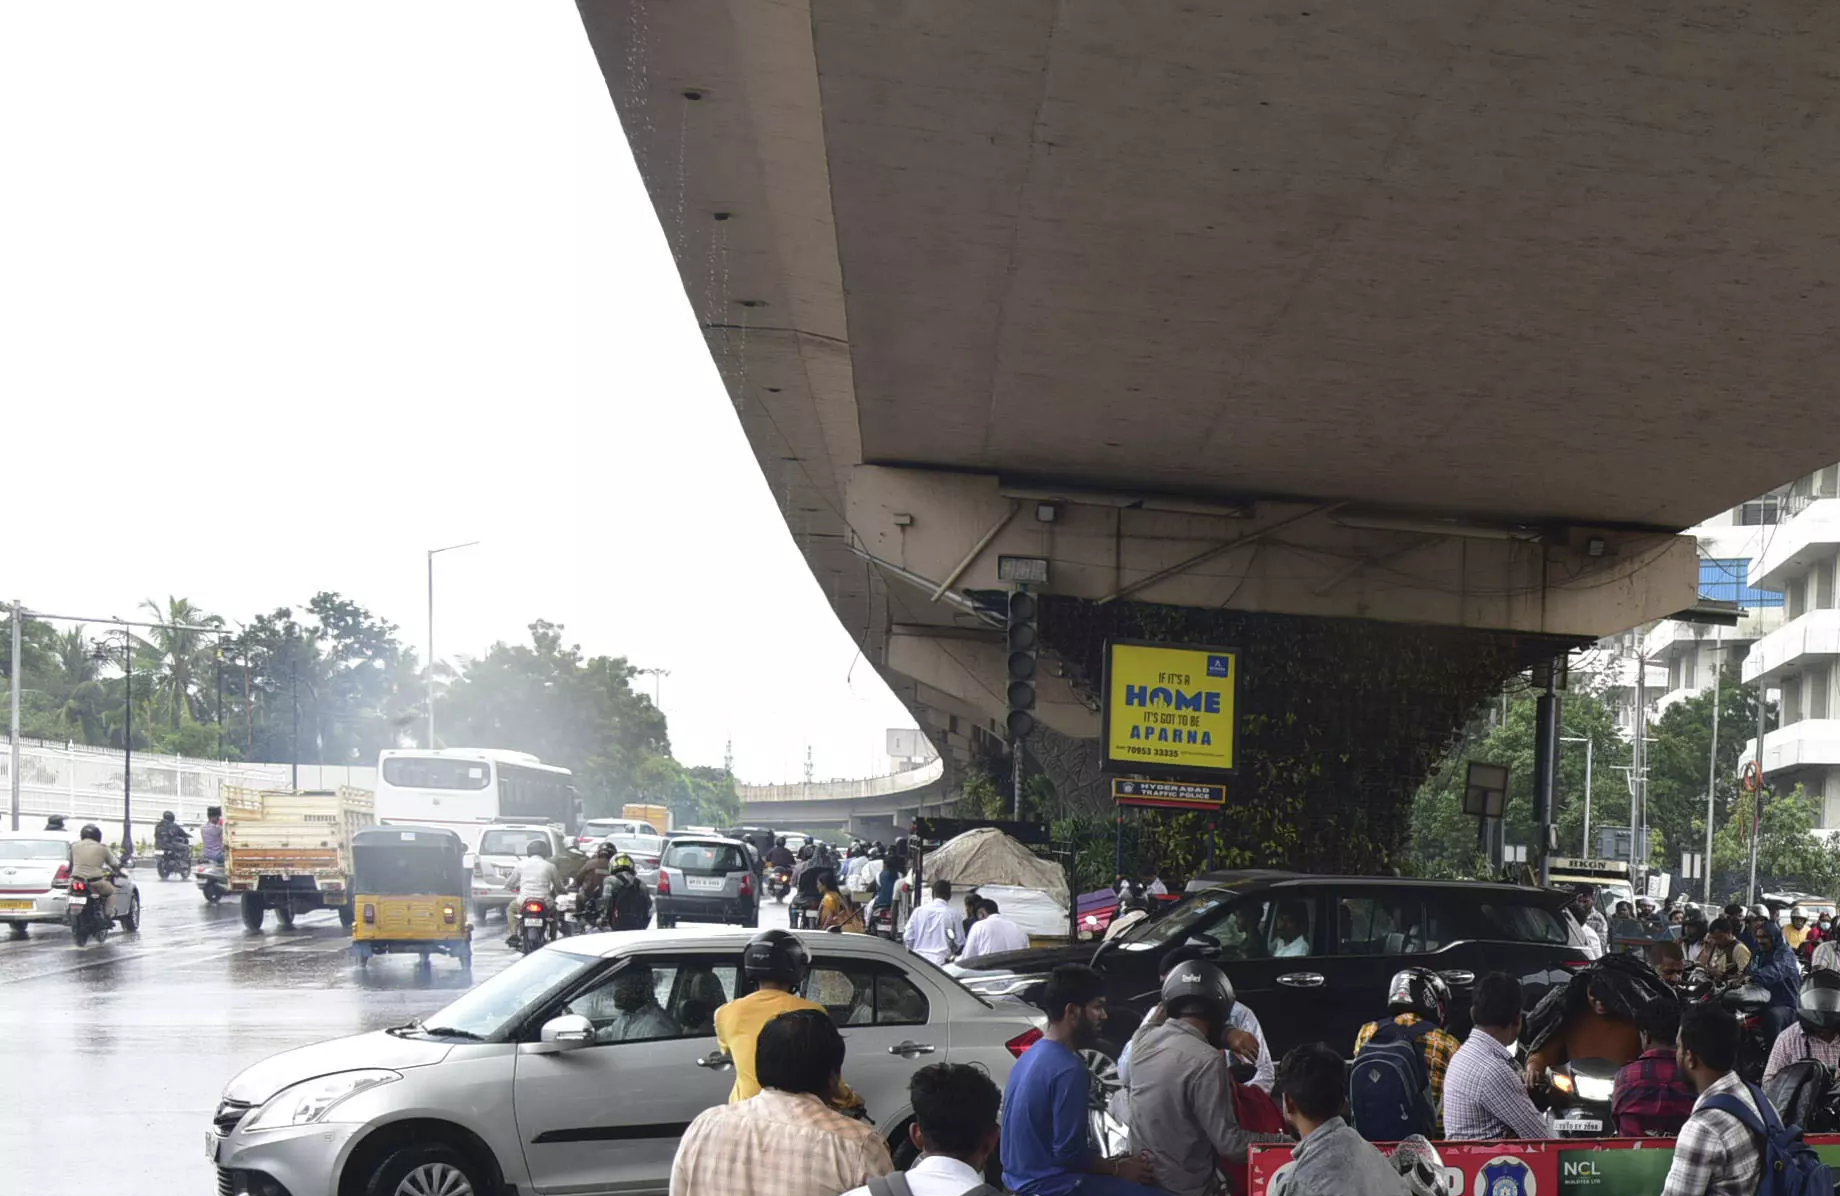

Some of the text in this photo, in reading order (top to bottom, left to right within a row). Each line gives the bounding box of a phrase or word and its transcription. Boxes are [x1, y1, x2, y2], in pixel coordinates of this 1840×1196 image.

[1158, 672, 1190, 685] IF IT'S A
[1125, 684, 1221, 714] HOME
[1144, 711, 1200, 727] IT'S GOT TO BE
[1130, 724, 1212, 745] APARNA
[1127, 746, 1151, 756] 70953
[1140, 783, 1210, 793] HYDERABAD
[1142, 789, 1210, 799] TRAFFIC POLICE
[1564, 1161, 1601, 1176] NCL
